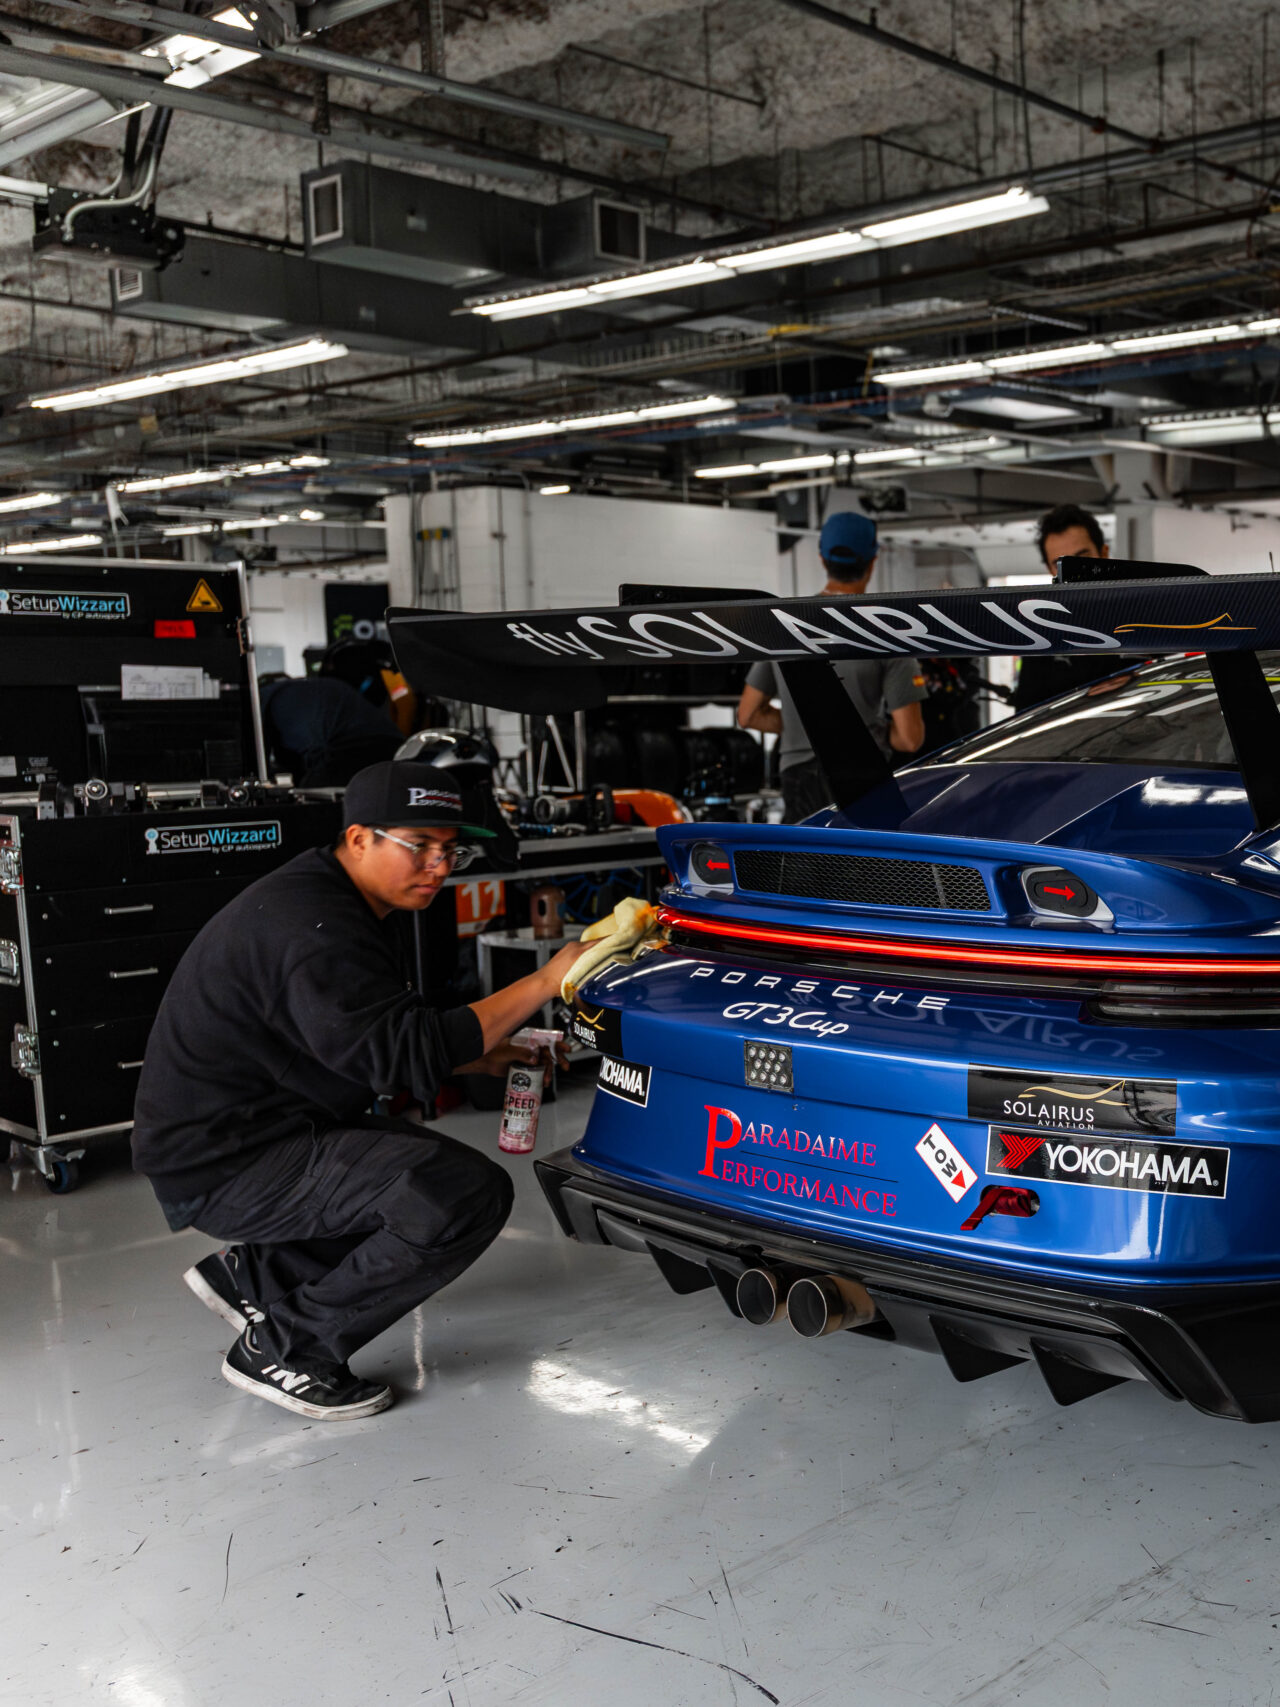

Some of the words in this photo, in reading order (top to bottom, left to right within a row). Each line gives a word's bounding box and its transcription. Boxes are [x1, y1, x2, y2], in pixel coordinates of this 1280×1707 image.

[11, 593, 126, 612] SetupWizzard
[160, 825, 277, 848] SetupWizzard
[221, 844, 234, 852] CP
[690, 967, 950, 1011] PORSCHE
[1003, 1099, 1095, 1123] SOLAIRUS
[1037, 1119, 1095, 1131] AVIATION
[922, 1134, 958, 1178] TOW
[1045, 1142, 1213, 1187] YOKOHAMA
